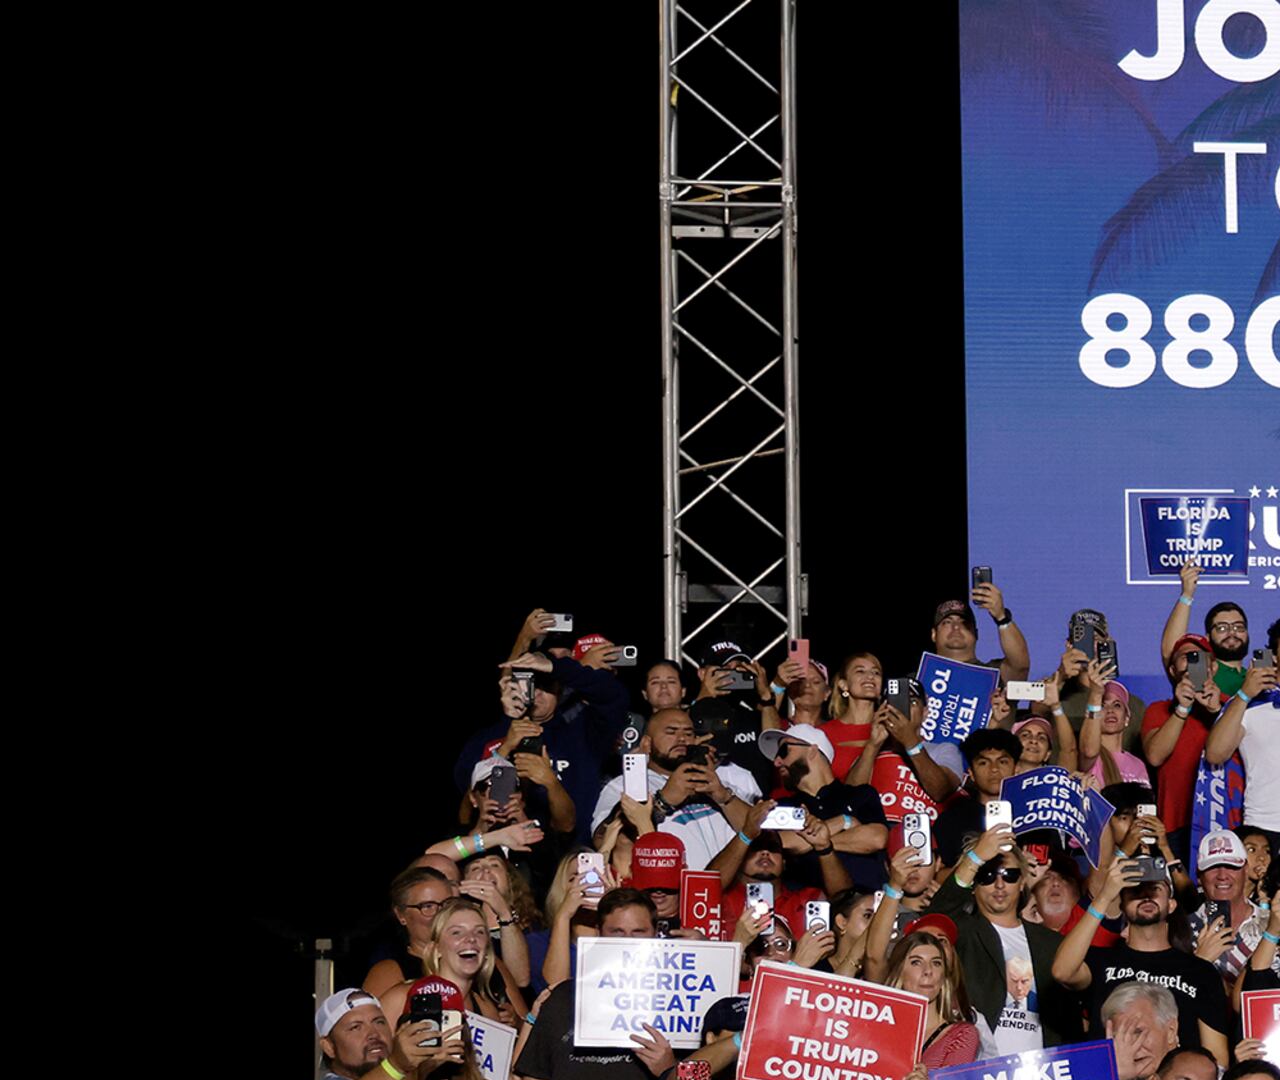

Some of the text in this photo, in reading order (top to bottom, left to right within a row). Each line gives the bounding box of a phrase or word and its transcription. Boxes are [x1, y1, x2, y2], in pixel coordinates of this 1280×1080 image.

[1158, 506, 1231, 521] FLORIDA
[1186, 522, 1202, 536] IS
[1166, 538, 1223, 552] TRUMP
[1160, 554, 1234, 567] COUNTRY
[920, 668, 951, 742] TO 8802
[940, 693, 960, 738] TRUMP
[953, 696, 979, 742] TEXT
[1051, 786, 1071, 799] IS
[621, 951, 696, 971] MAKE
[416, 980, 458, 995] TRUMP
[597, 972, 717, 993] AMERICA
[1135, 969, 1198, 999] Angeles
[613, 994, 702, 1013] GREAT
[784, 986, 896, 1025] FLORIDA
[610, 1014, 701, 1034] AGAIN!
[999, 1010, 1025, 1022] EVER
[824, 1017, 849, 1040] IS
[787, 1034, 879, 1068] TRUMP
